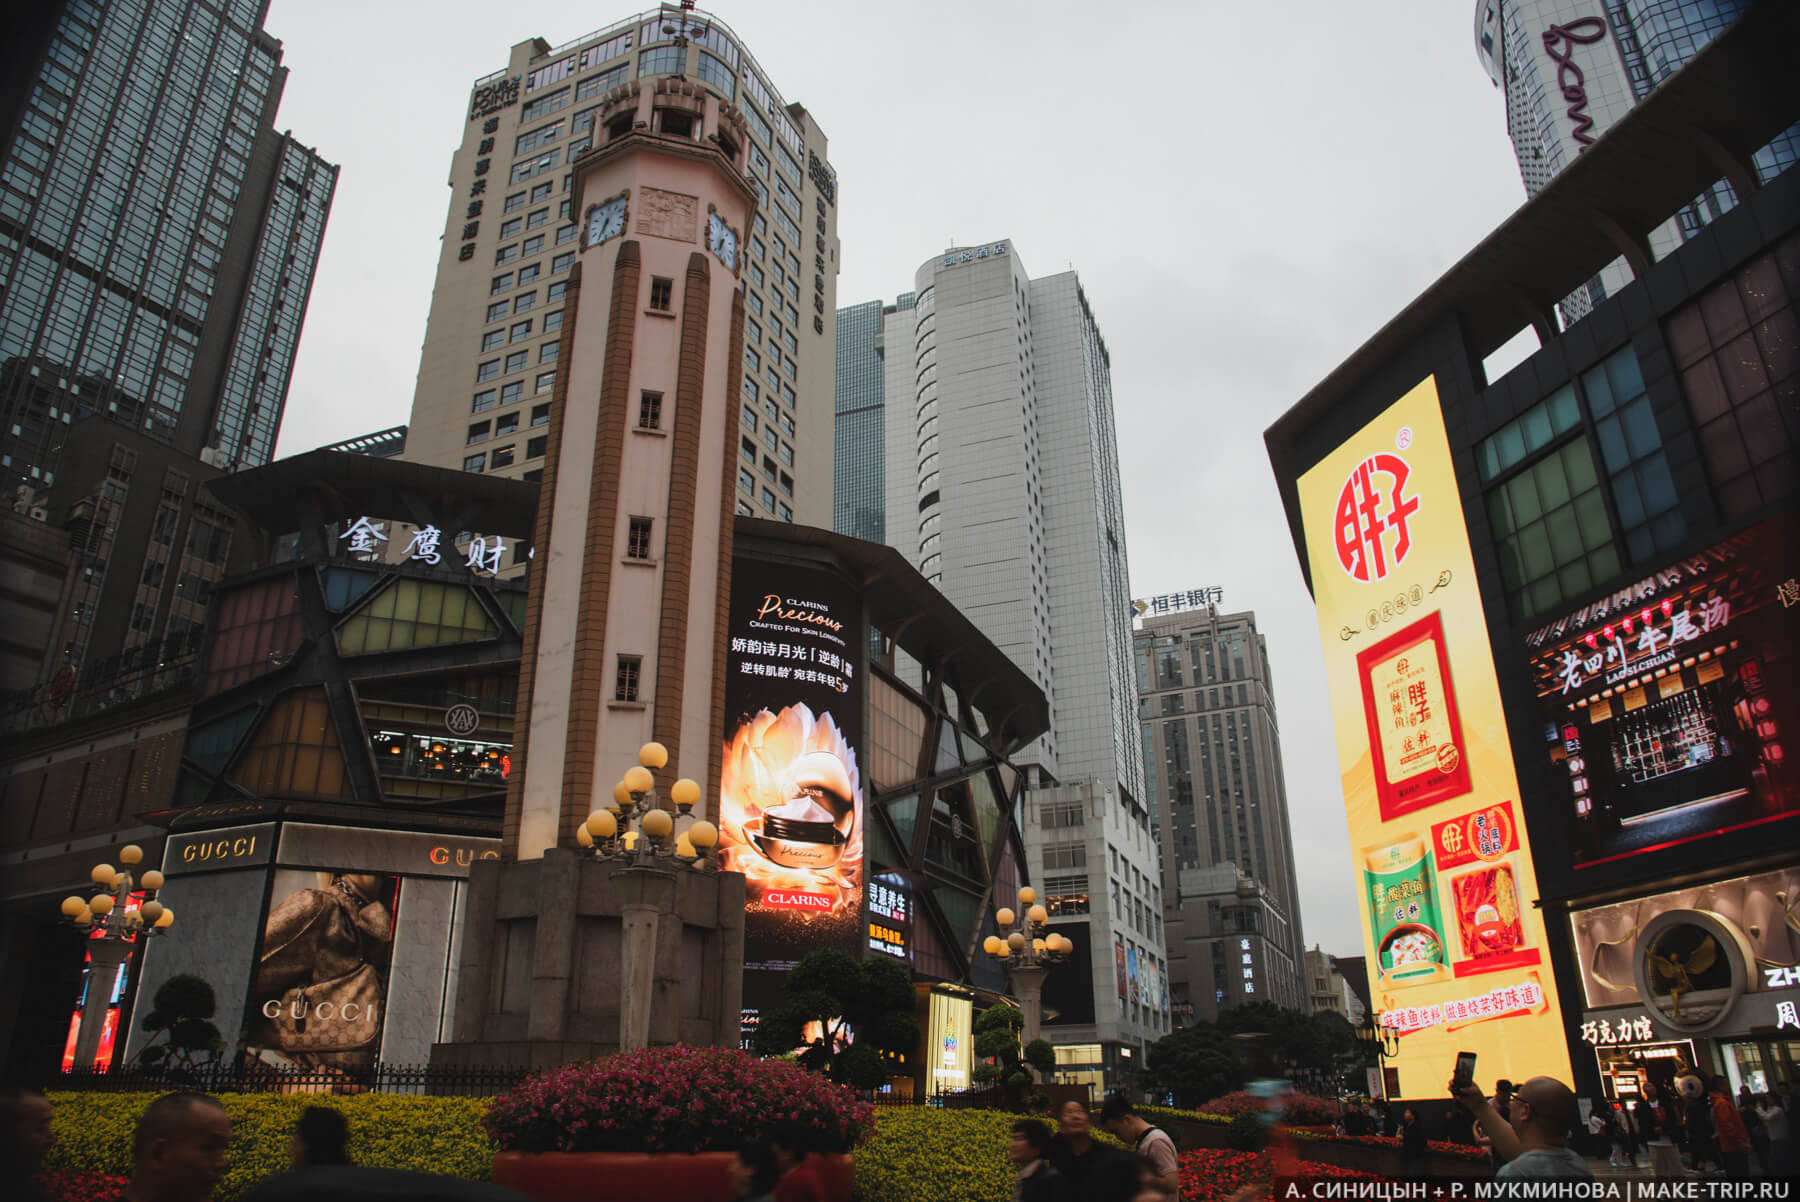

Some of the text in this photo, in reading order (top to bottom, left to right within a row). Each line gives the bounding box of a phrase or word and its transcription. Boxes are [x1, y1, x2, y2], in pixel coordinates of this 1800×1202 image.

[338, 515, 536, 575] 金鹰财
[756, 594, 844, 632] Precious
[786, 598, 829, 612] CLARINS
[1151, 586, 1224, 614] 恒丰银行
[183, 835, 257, 863] GUCCI
[767, 892, 831, 908] CLARINS
[262, 1000, 373, 1022] GUCCI
[1579, 1015, 1653, 1045] 巧克力馆
